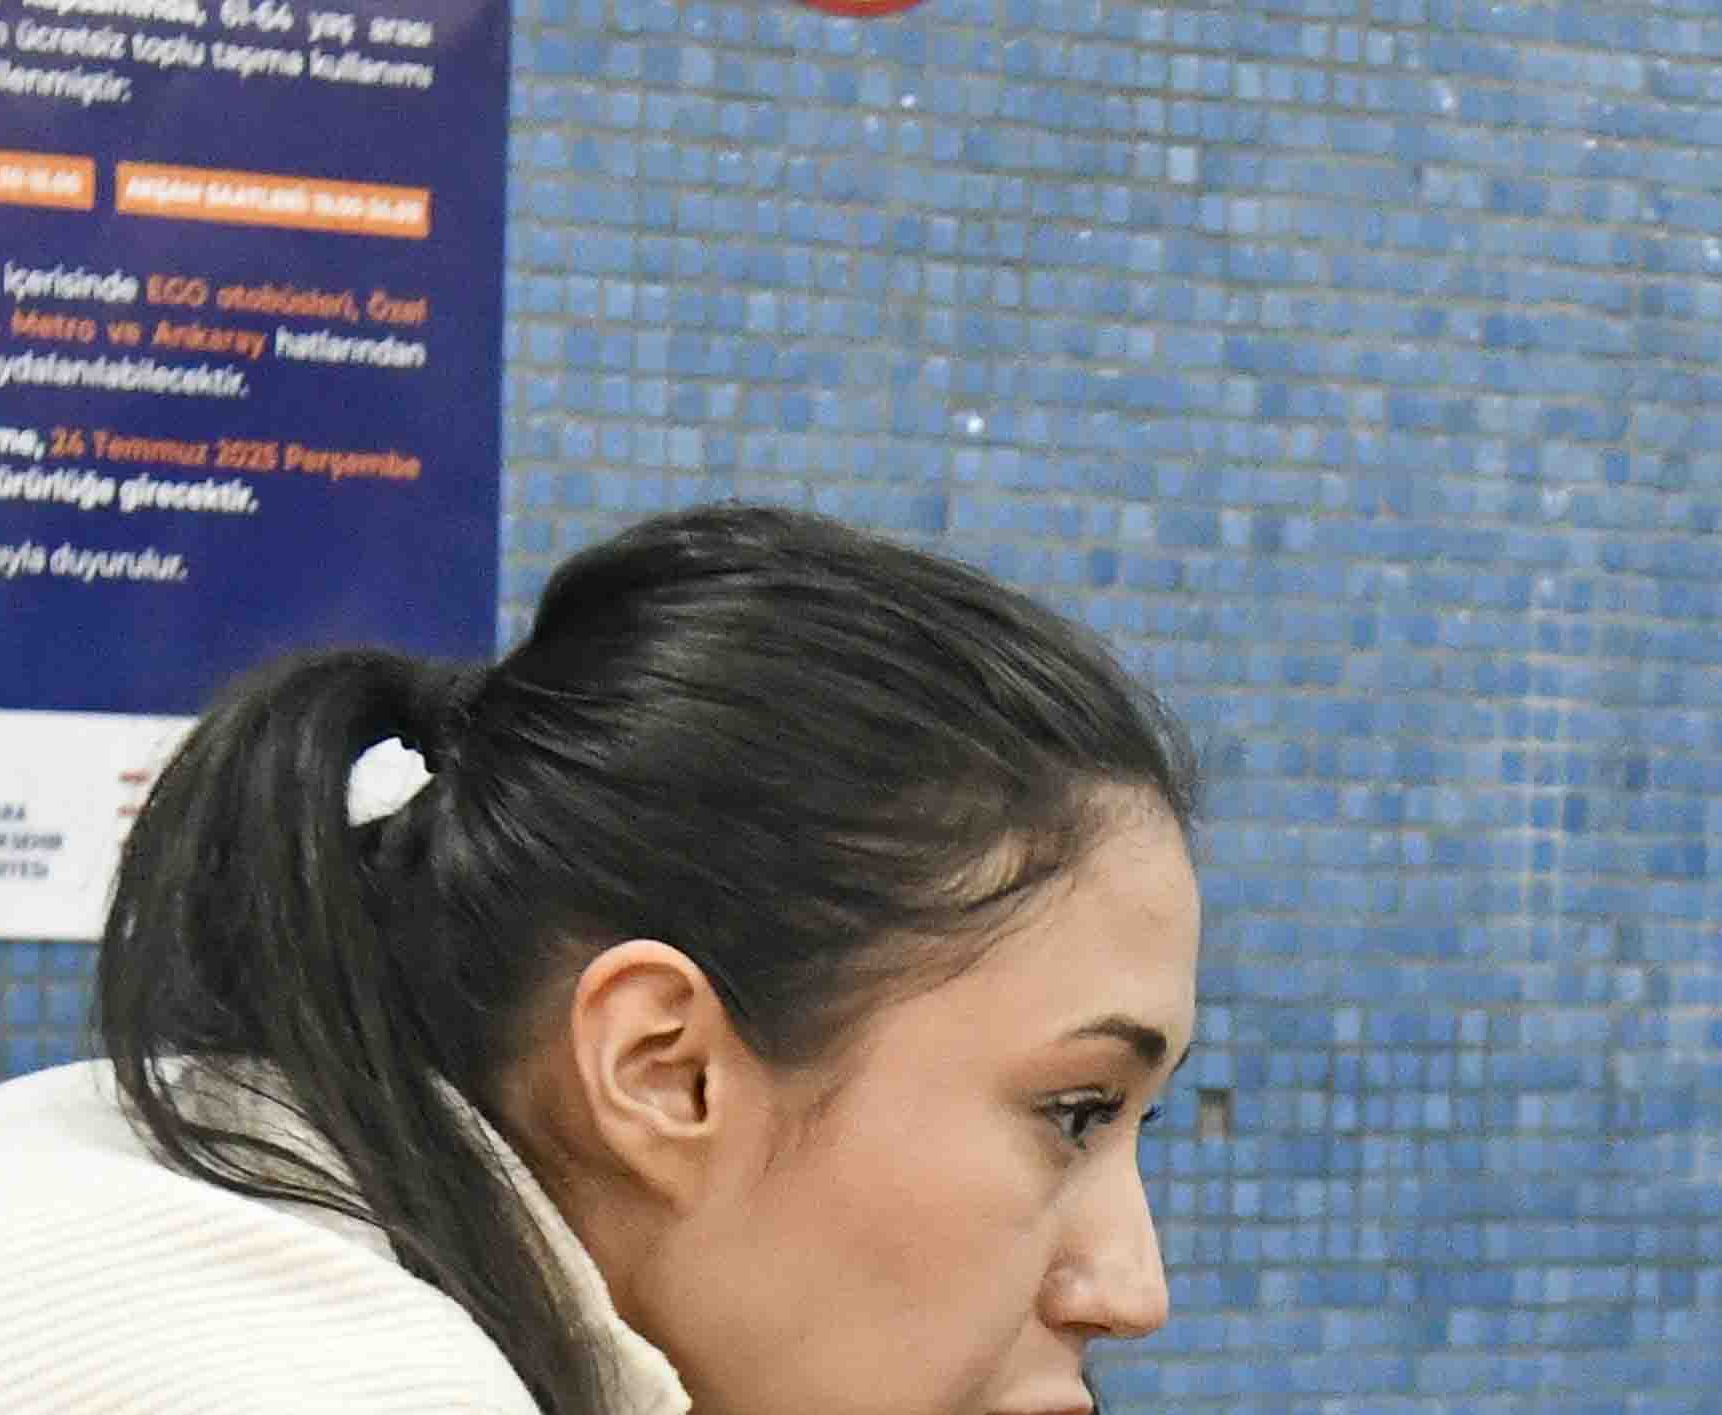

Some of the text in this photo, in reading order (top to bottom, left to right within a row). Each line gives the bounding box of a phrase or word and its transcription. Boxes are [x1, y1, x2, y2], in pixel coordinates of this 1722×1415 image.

[15, 17, 127, 60] ücretsiz
[131, 32, 206, 70] toplu
[211, 41, 305, 80] taşıma
[309, 48, 434, 90] kullanımı
[308, 11, 356, 46] yaş
[369, 16, 433, 48] arası
[4, 257, 141, 304] içerisinde
[146, 272, 209, 306] EGO
[216, 280, 360, 325] otobüsleri,
[367, 288, 427, 327] Özel
[11, 308, 96, 344] Metro
[107, 319, 141, 345] ve
[151, 318, 268, 360] Ankaray
[276, 324, 427, 369] hatlarından
[93, 430, 210, 467] Temmuz
[284, 444, 422, 482] Perşembe
[120, 471, 260, 515] girecektir.
[49, 542, 188, 585] duyurulur.
